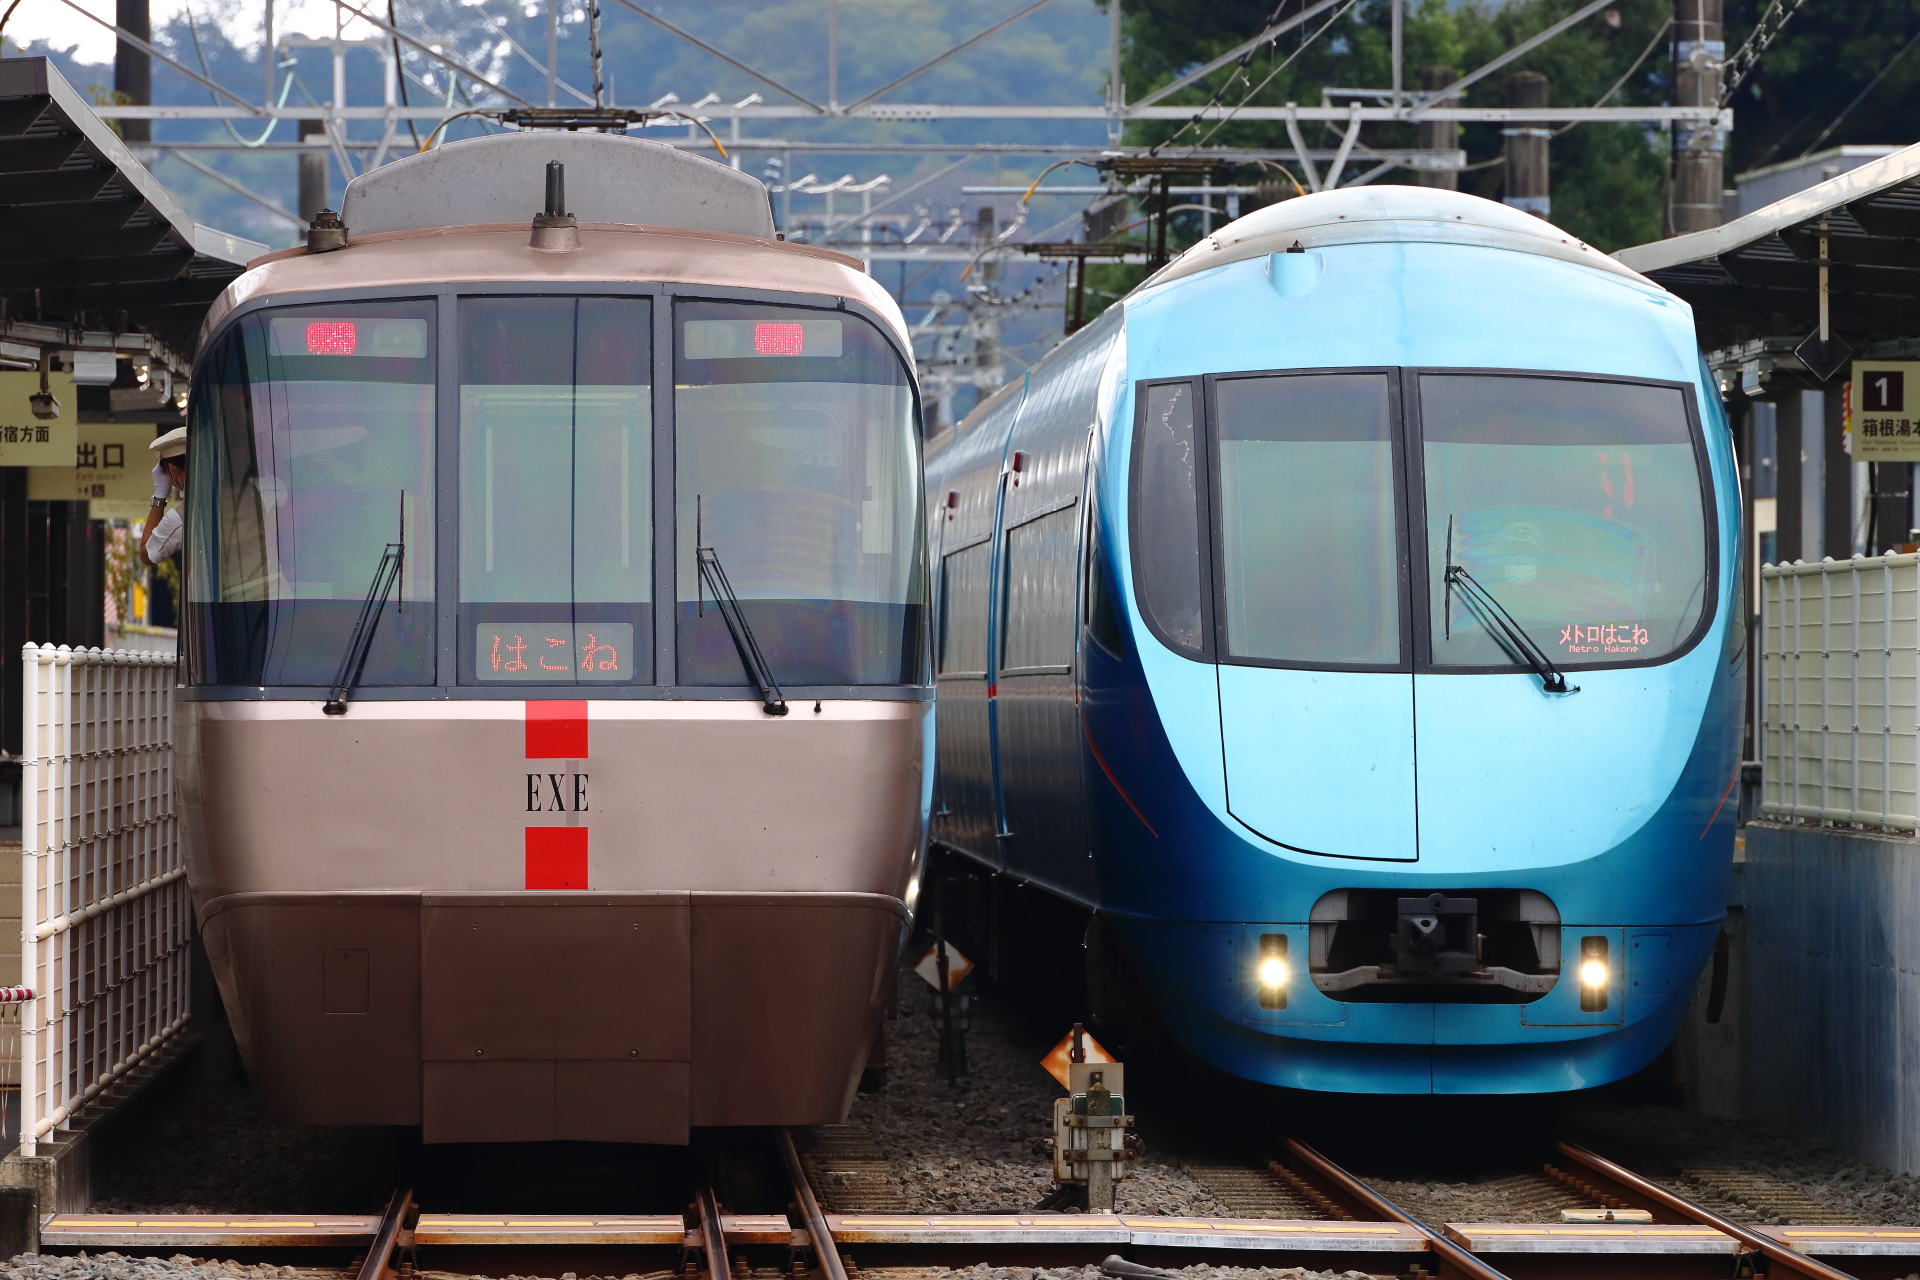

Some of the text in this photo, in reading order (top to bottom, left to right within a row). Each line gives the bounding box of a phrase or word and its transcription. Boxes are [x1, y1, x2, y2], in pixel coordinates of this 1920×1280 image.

[1875, 377, 1888, 406] 1
[0, 426, 49, 443] 宿方面
[77, 442, 125, 469] 出口
[1559, 624, 1649, 645] メトロはこね
[491, 634, 618, 671] はこね
[1569, 645, 1638, 653] Metro Hakone
[525, 773, 589, 812] EXE
